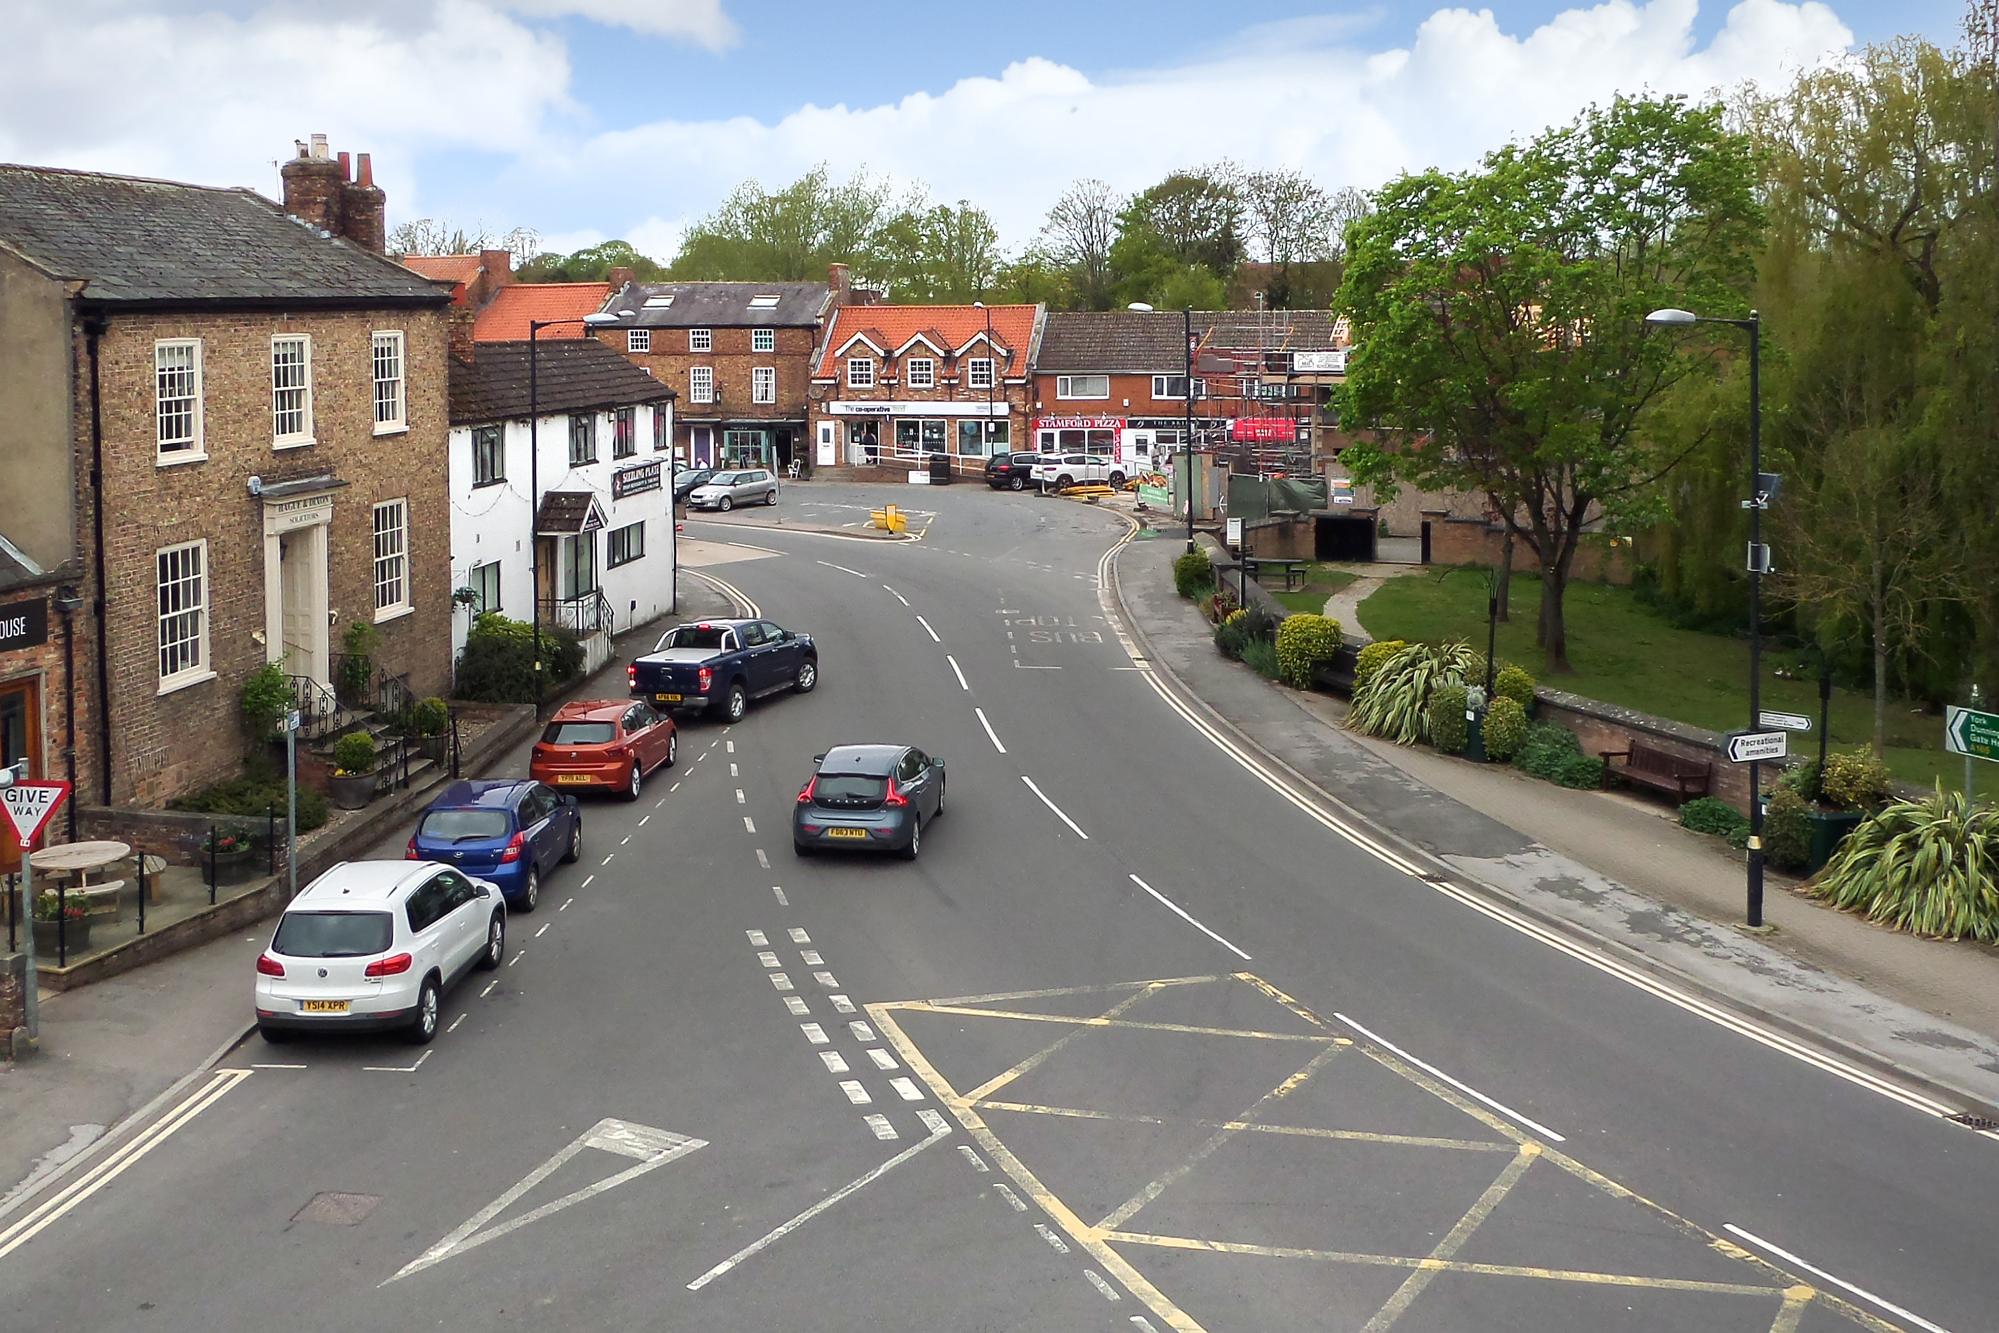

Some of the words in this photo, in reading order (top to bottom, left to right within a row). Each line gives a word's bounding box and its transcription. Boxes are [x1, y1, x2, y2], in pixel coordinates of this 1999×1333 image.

[1038, 419, 1091, 428] STAMFORD
[1095, 419, 1121, 428] PIZZA
[0, 616, 27, 640] OUSE
[1970, 714, 1987, 725] York
[1740, 735, 1784, 747] Recreational
[1745, 746, 1779, 756] amenities
[5, 788, 50, 804] GIVE
[13, 805, 42, 817] WAY
